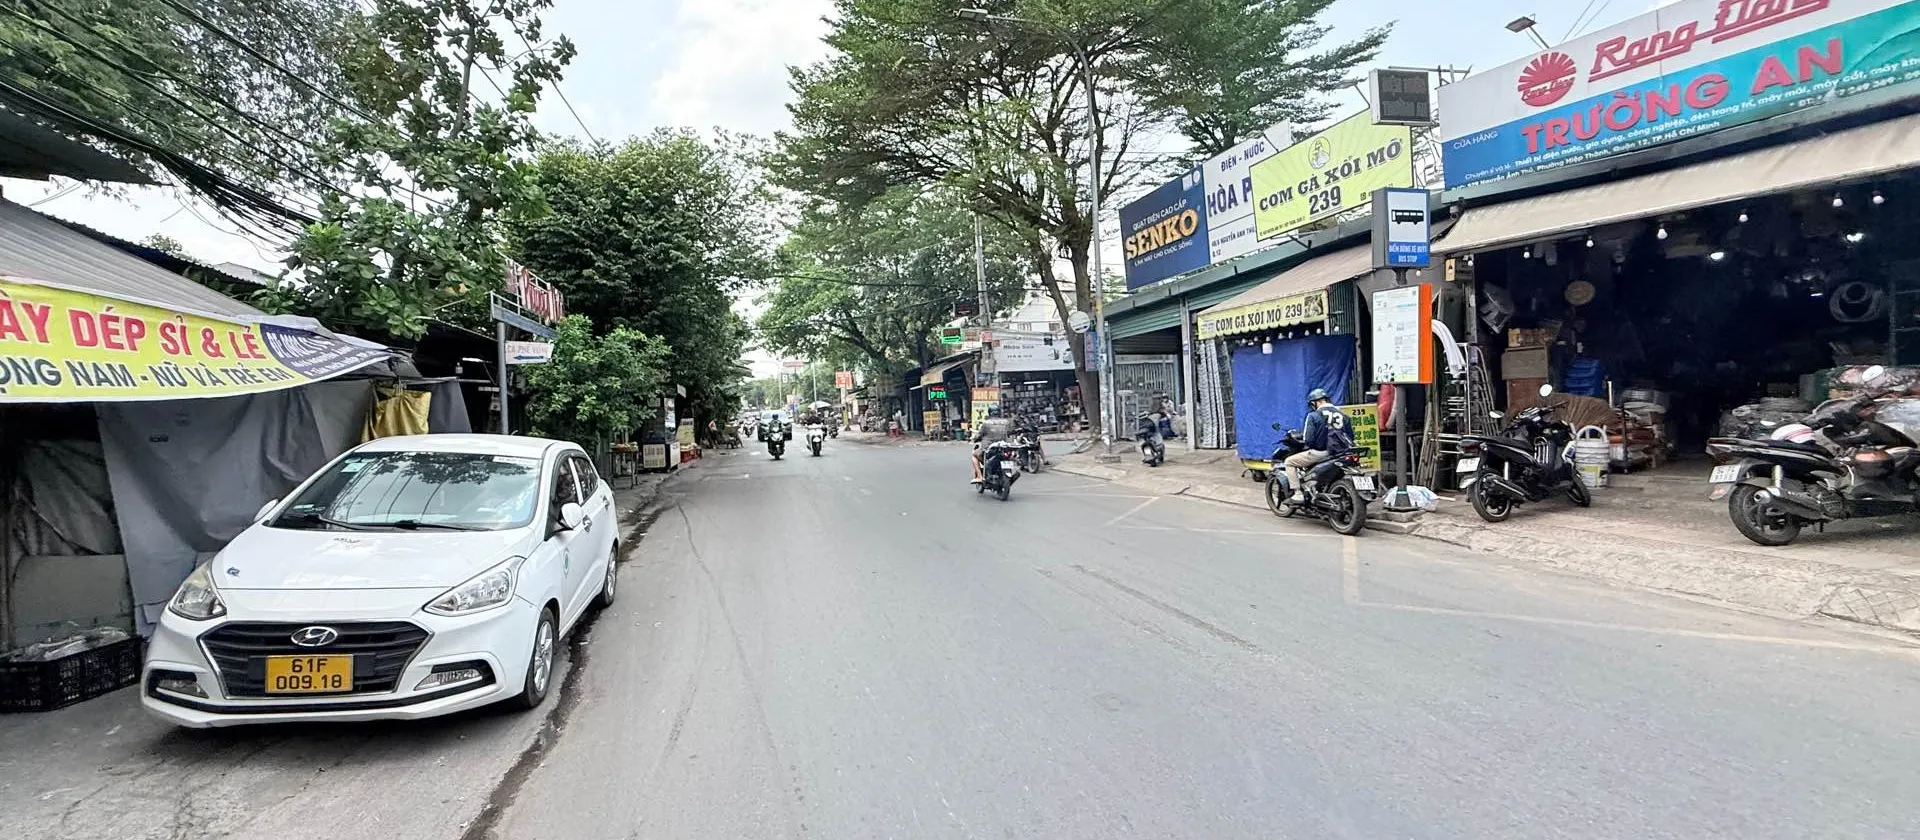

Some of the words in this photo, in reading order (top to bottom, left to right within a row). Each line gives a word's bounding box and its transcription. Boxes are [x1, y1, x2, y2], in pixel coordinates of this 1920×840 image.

[1522, 73, 1730, 154] TRƯỜNG
[1751, 38, 1843, 95] AN
[1600, 133, 1625, 145] dụng,
[1628, 127, 1651, 138] công
[1652, 117, 1687, 132] nghiệp,
[1690, 110, 1710, 122] đèn
[1712, 103, 1739, 117] trang
[1758, 92, 1782, 105] máy
[1813, 78, 1840, 91] máy
[1871, 62, 1899, 75] máy
[1472, 130, 1499, 145] HÀNG
[1613, 142, 1636, 153] Quận
[1679, 125, 1696, 137] Chí
[1697, 122, 1720, 132] Minh
[1220, 157, 1237, 173] ĐIỆN
[1243, 140, 1265, 161] NƯỚC
[1259, 186, 1294, 212] CƠM
[1297, 173, 1320, 195] GÀ
[1324, 155, 1361, 186] XỐI
[1367, 137, 1403, 169] MỠ
[1160, 206, 1174, 218] CAO
[1174, 198, 1187, 211] CẤP
[1207, 184, 1239, 218] HÒA
[1308, 185, 1342, 216] 239
[1125, 209, 1198, 260] SENKO
[1407, 255, 1418, 263] STOP
[1285, 303, 1302, 319] 239
[68, 306, 146, 351] DÉP
[160, 315, 192, 355] SỈ
[201, 328, 225, 357] &
[228, 325, 267, 359] LẺ
[65, 360, 138, 387] NAM
[148, 361, 188, 387] NỮ
[185, 361, 226, 387] VÀ
[219, 361, 264, 385] TRẺ
[256, 367, 295, 381] EM
[1322, 410, 1343, 430] 73
[291, 658, 328, 672] 61F
[276, 674, 342, 690] 009.18
